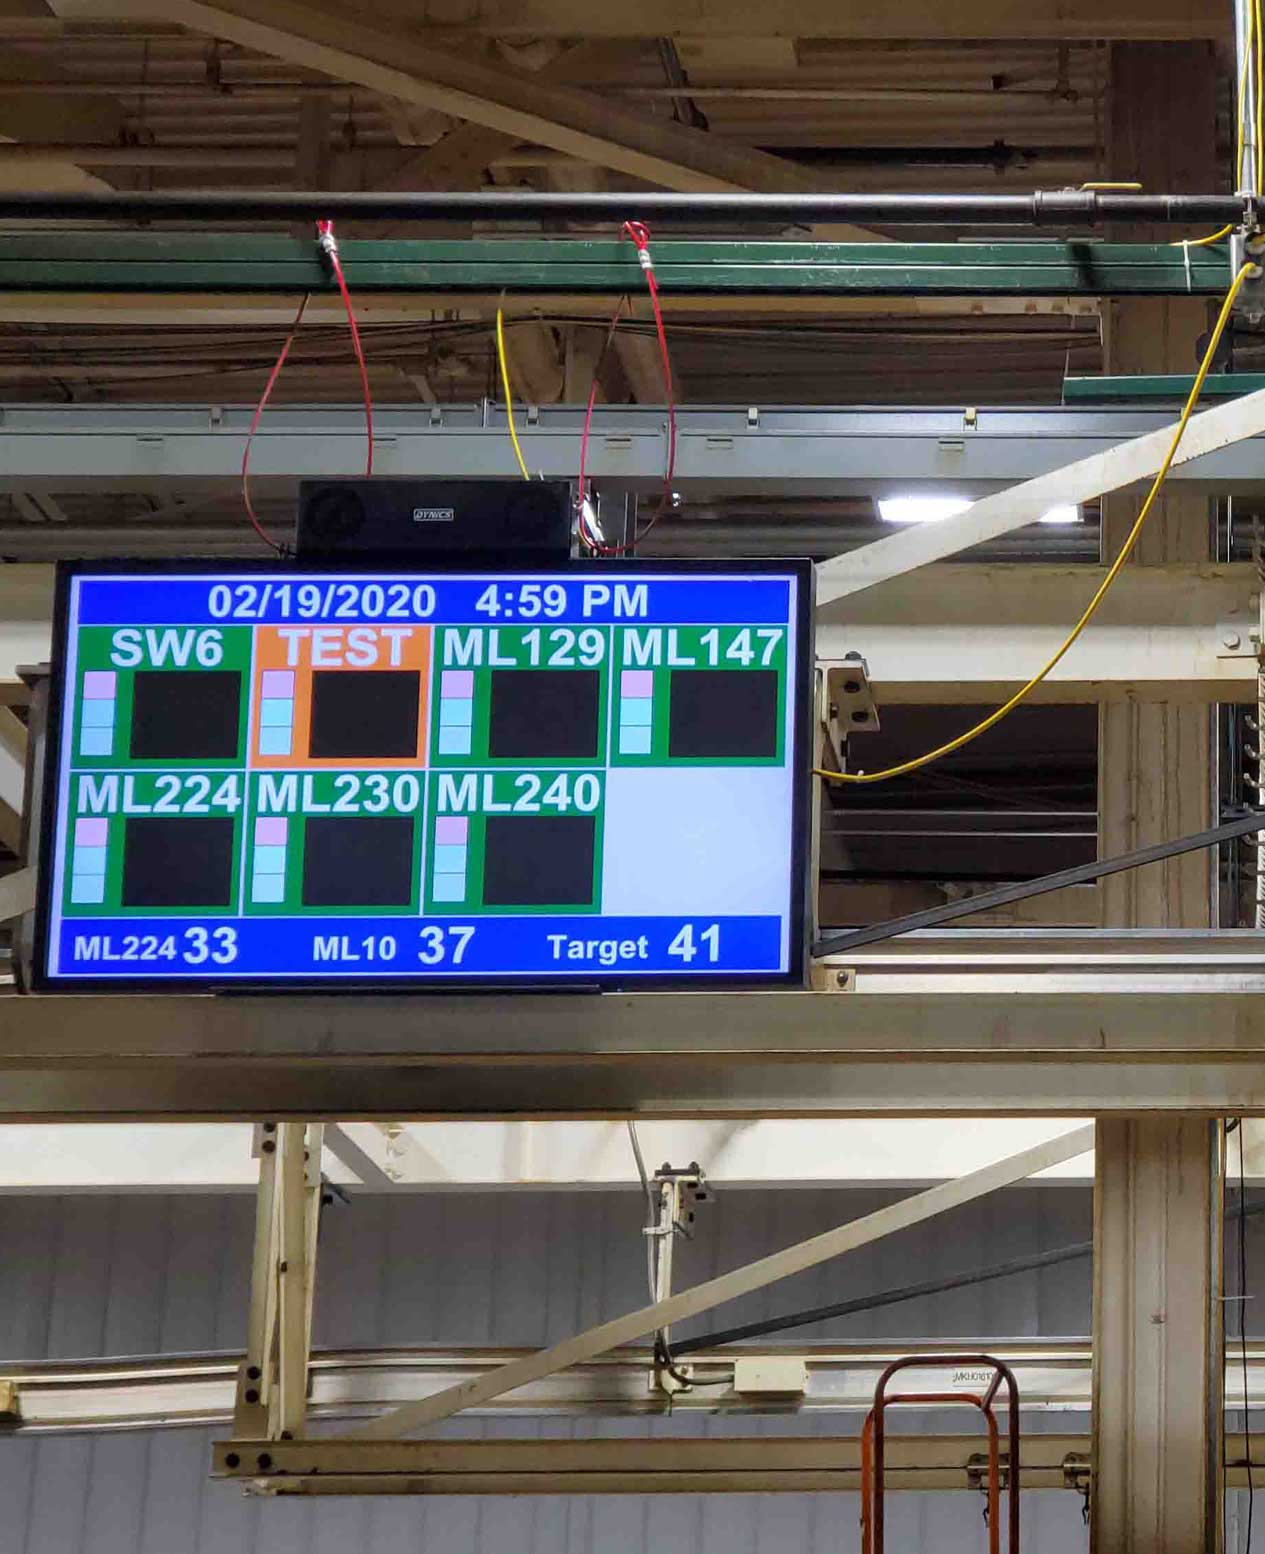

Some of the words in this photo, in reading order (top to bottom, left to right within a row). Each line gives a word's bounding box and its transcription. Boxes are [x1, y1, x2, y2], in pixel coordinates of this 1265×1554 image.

[415, 511, 451, 519] DYNICS
[209, 584, 436, 618] 02/19/2020
[476, 584, 567, 617] 4:59
[583, 584, 648, 617] PM
[111, 629, 222, 667] SW6
[277, 628, 414, 667] TEST
[444, 628, 605, 666] ML129
[623, 628, 783, 666] ML147
[79, 775, 241, 813] ML224
[258, 774, 420, 812] ML230
[437, 773, 600, 811] ML240
[75, 936, 176, 960] ML224
[184, 926, 237, 964] 33
[314, 936, 396, 960] ML10
[418, 926, 475, 964] 37
[547, 935, 648, 965] Target
[668, 924, 719, 962] 41
